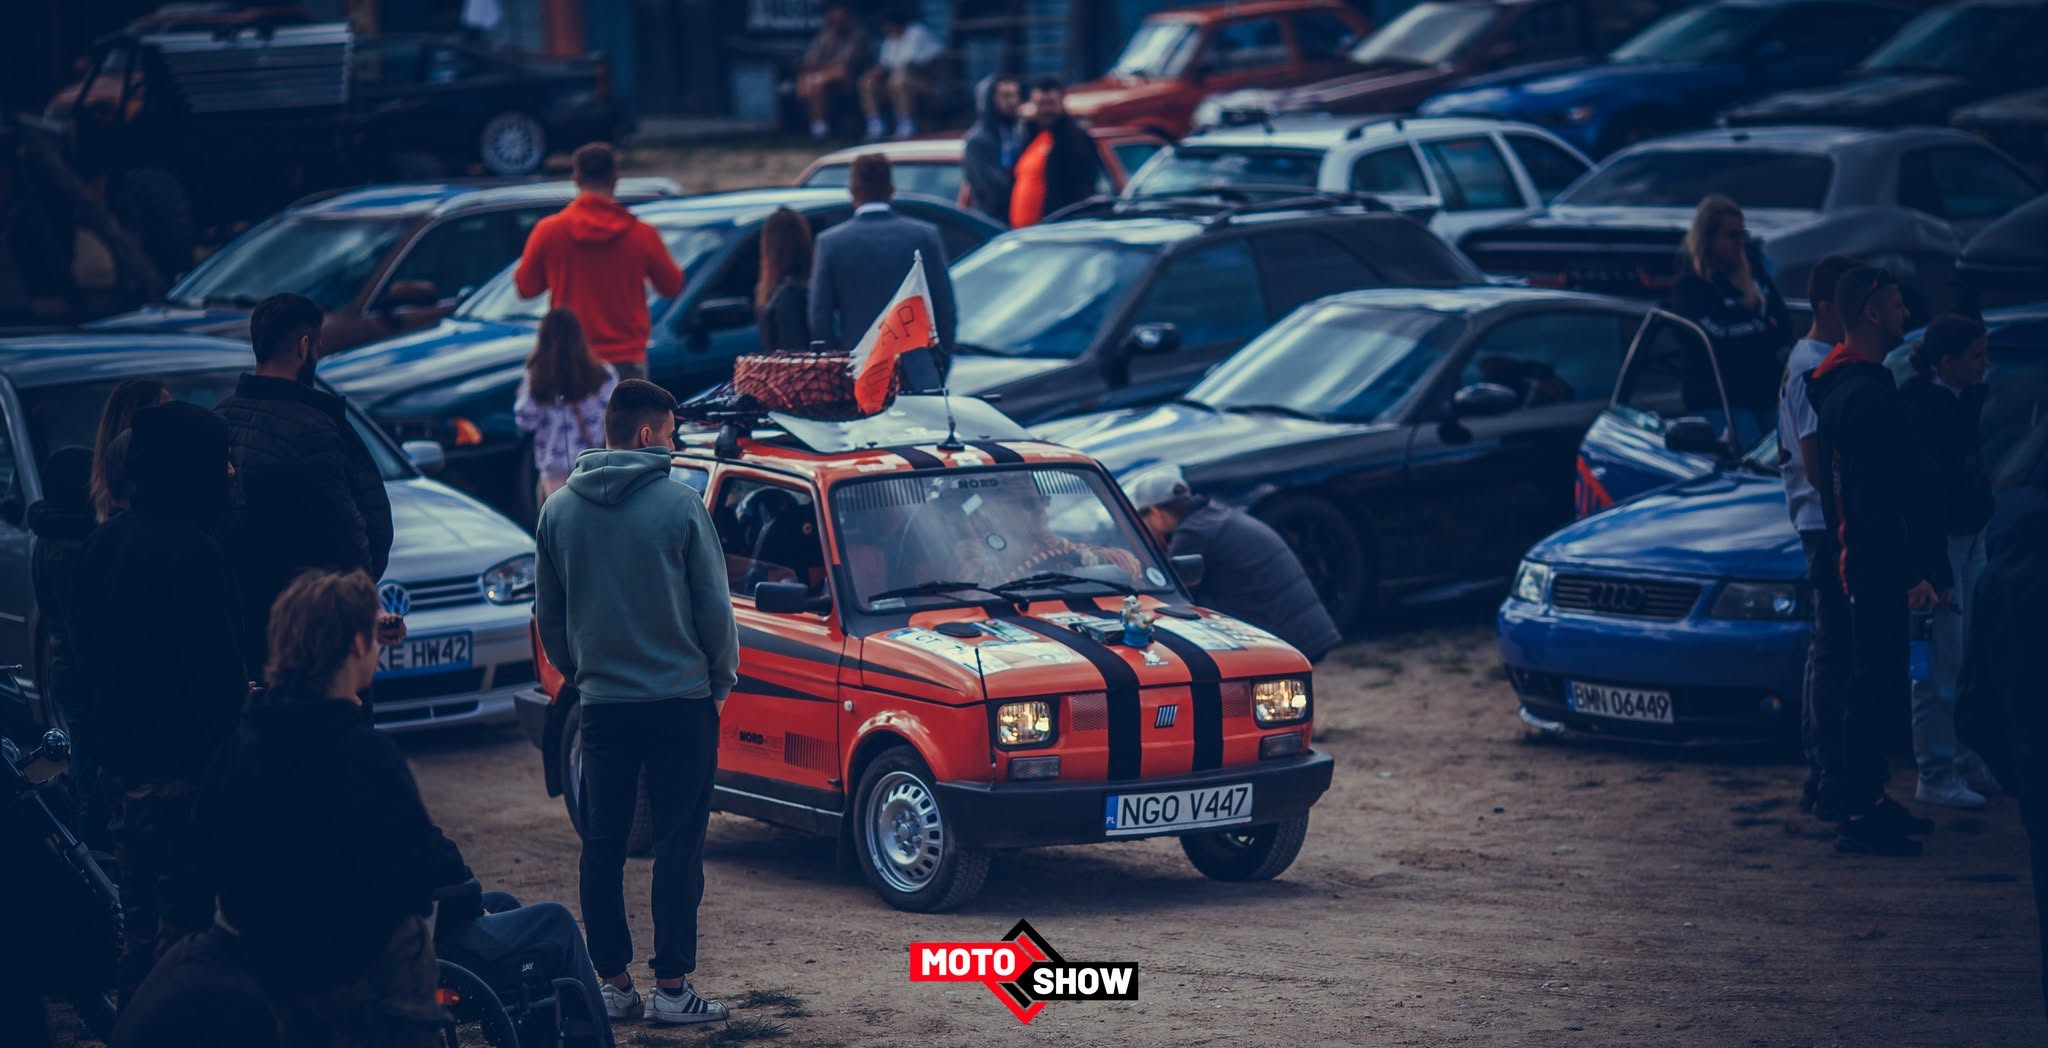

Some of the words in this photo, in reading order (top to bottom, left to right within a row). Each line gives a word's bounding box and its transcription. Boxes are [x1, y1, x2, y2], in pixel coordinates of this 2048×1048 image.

[1611, 690, 1669, 719] 06449
[1121, 794, 1180, 827] NGO
[1190, 786, 1249, 821] V447
